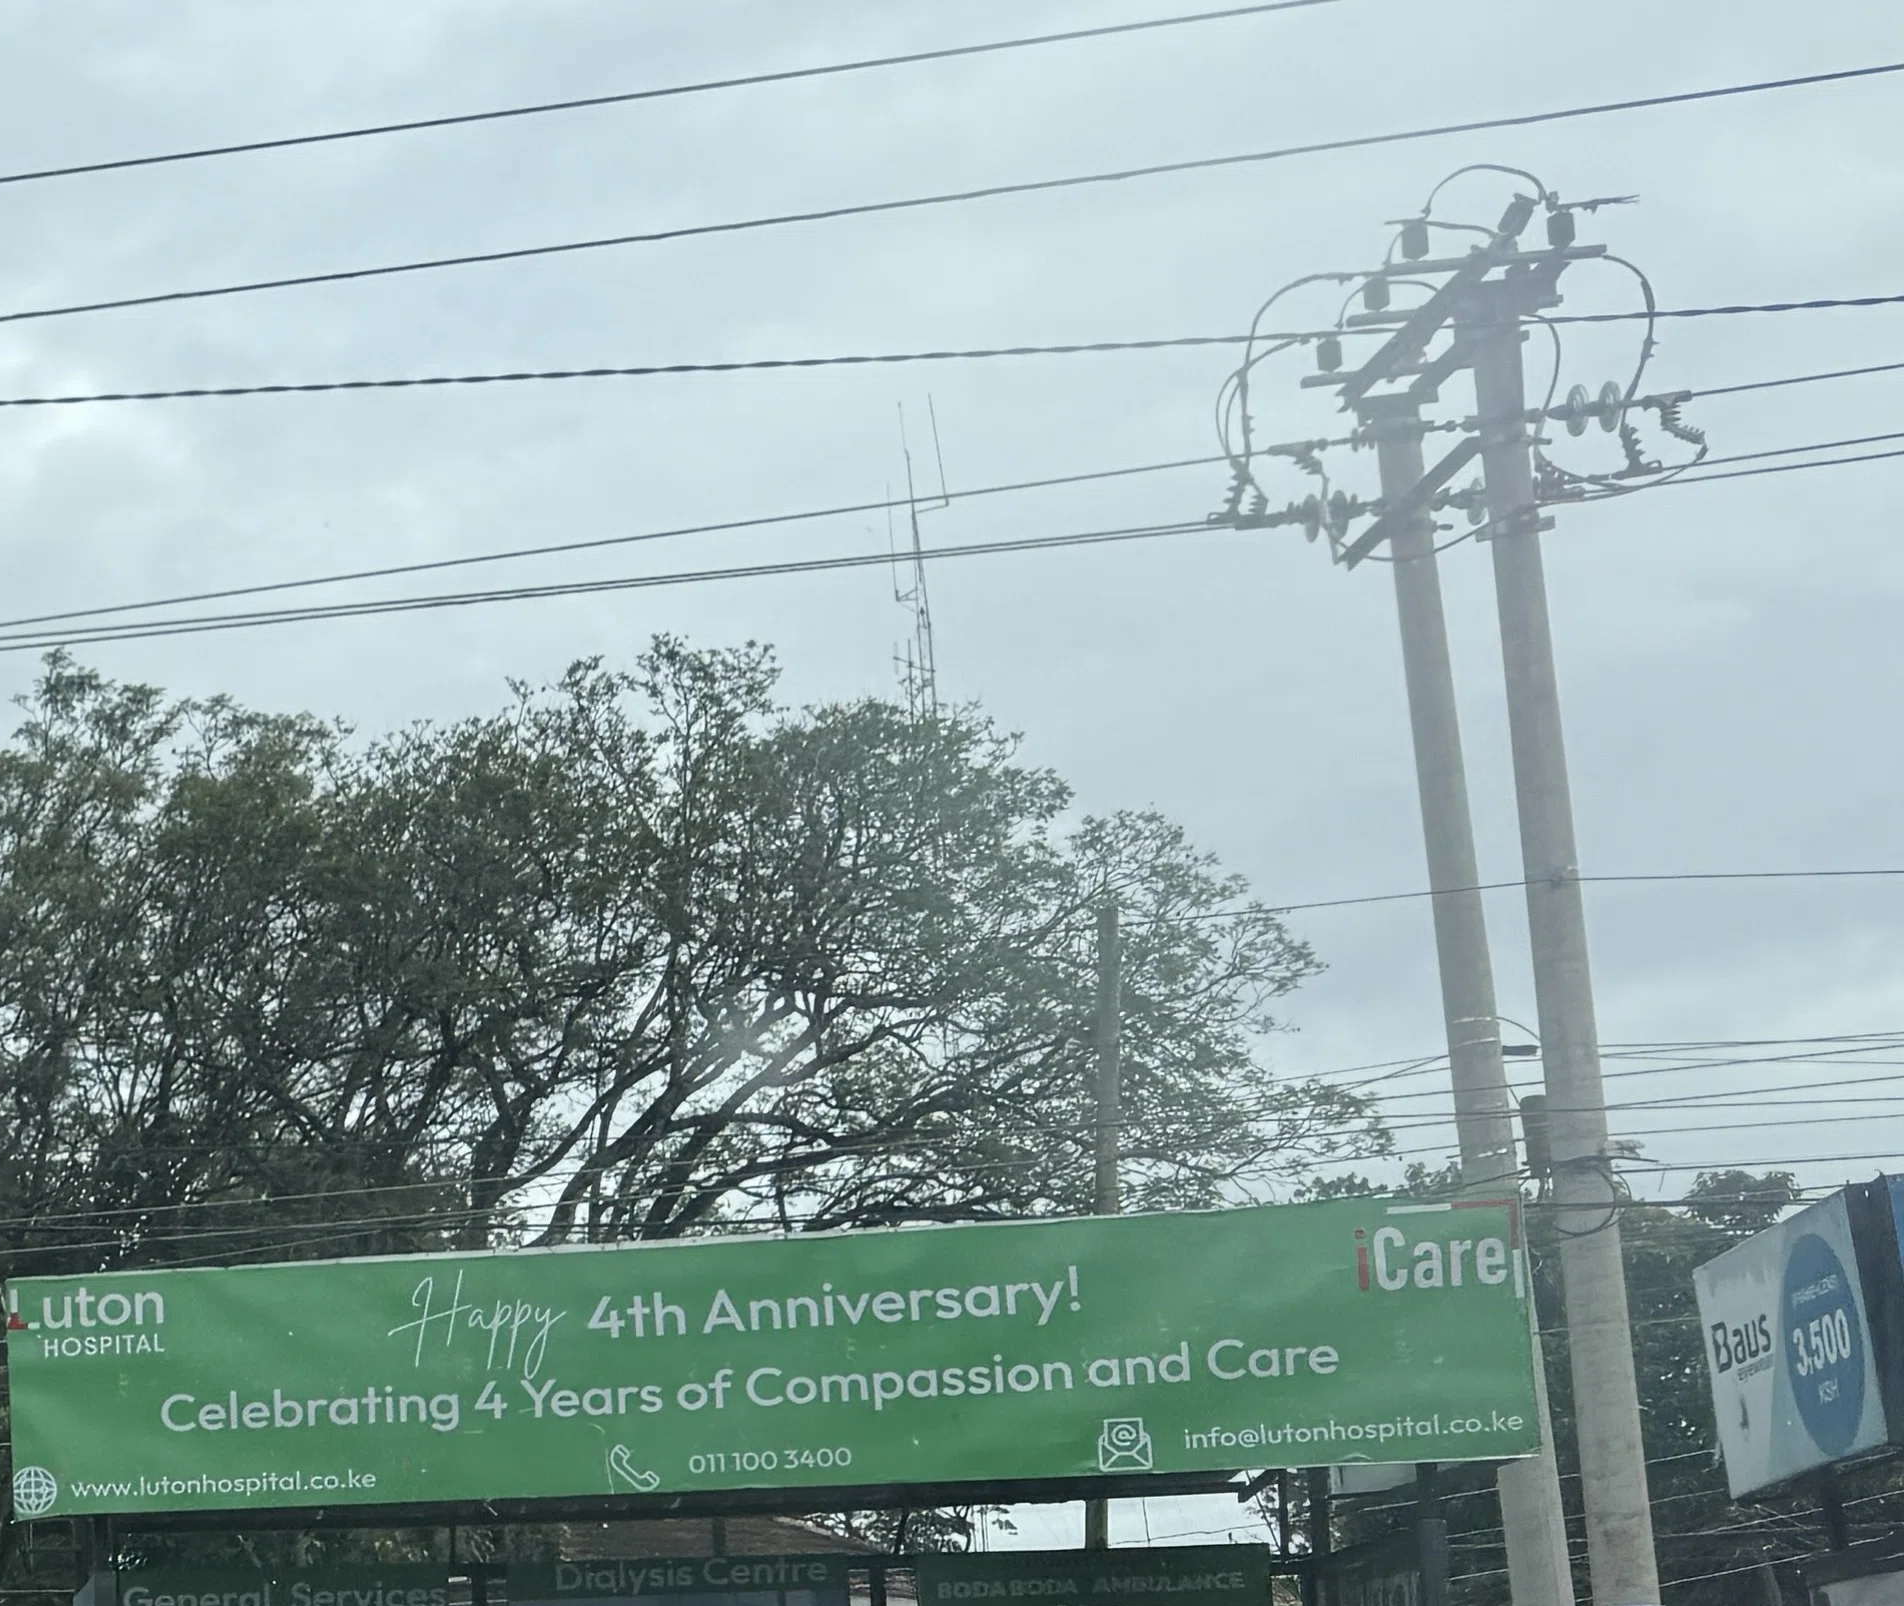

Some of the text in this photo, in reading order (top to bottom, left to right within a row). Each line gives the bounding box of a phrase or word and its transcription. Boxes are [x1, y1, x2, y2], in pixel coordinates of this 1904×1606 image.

[1355, 1226, 1507, 1292] iCare
[389, 1265, 1082, 1378] Happy 4th Anniversary!
[43, 1335, 165, 1358] HOSPITAL
[1793, 1308, 1851, 1376] 3,500
[161, 1338, 1340, 1432] Celebrating 4 Years of Compassion and Care
[1183, 1410, 1524, 1450] info@lutonhospital.co.ke
[783, 1447, 852, 1471] 3400
[70, 1468, 377, 1499] www.lutonhospital.co.ke
[556, 1556, 829, 1595] Dialysis Centre
